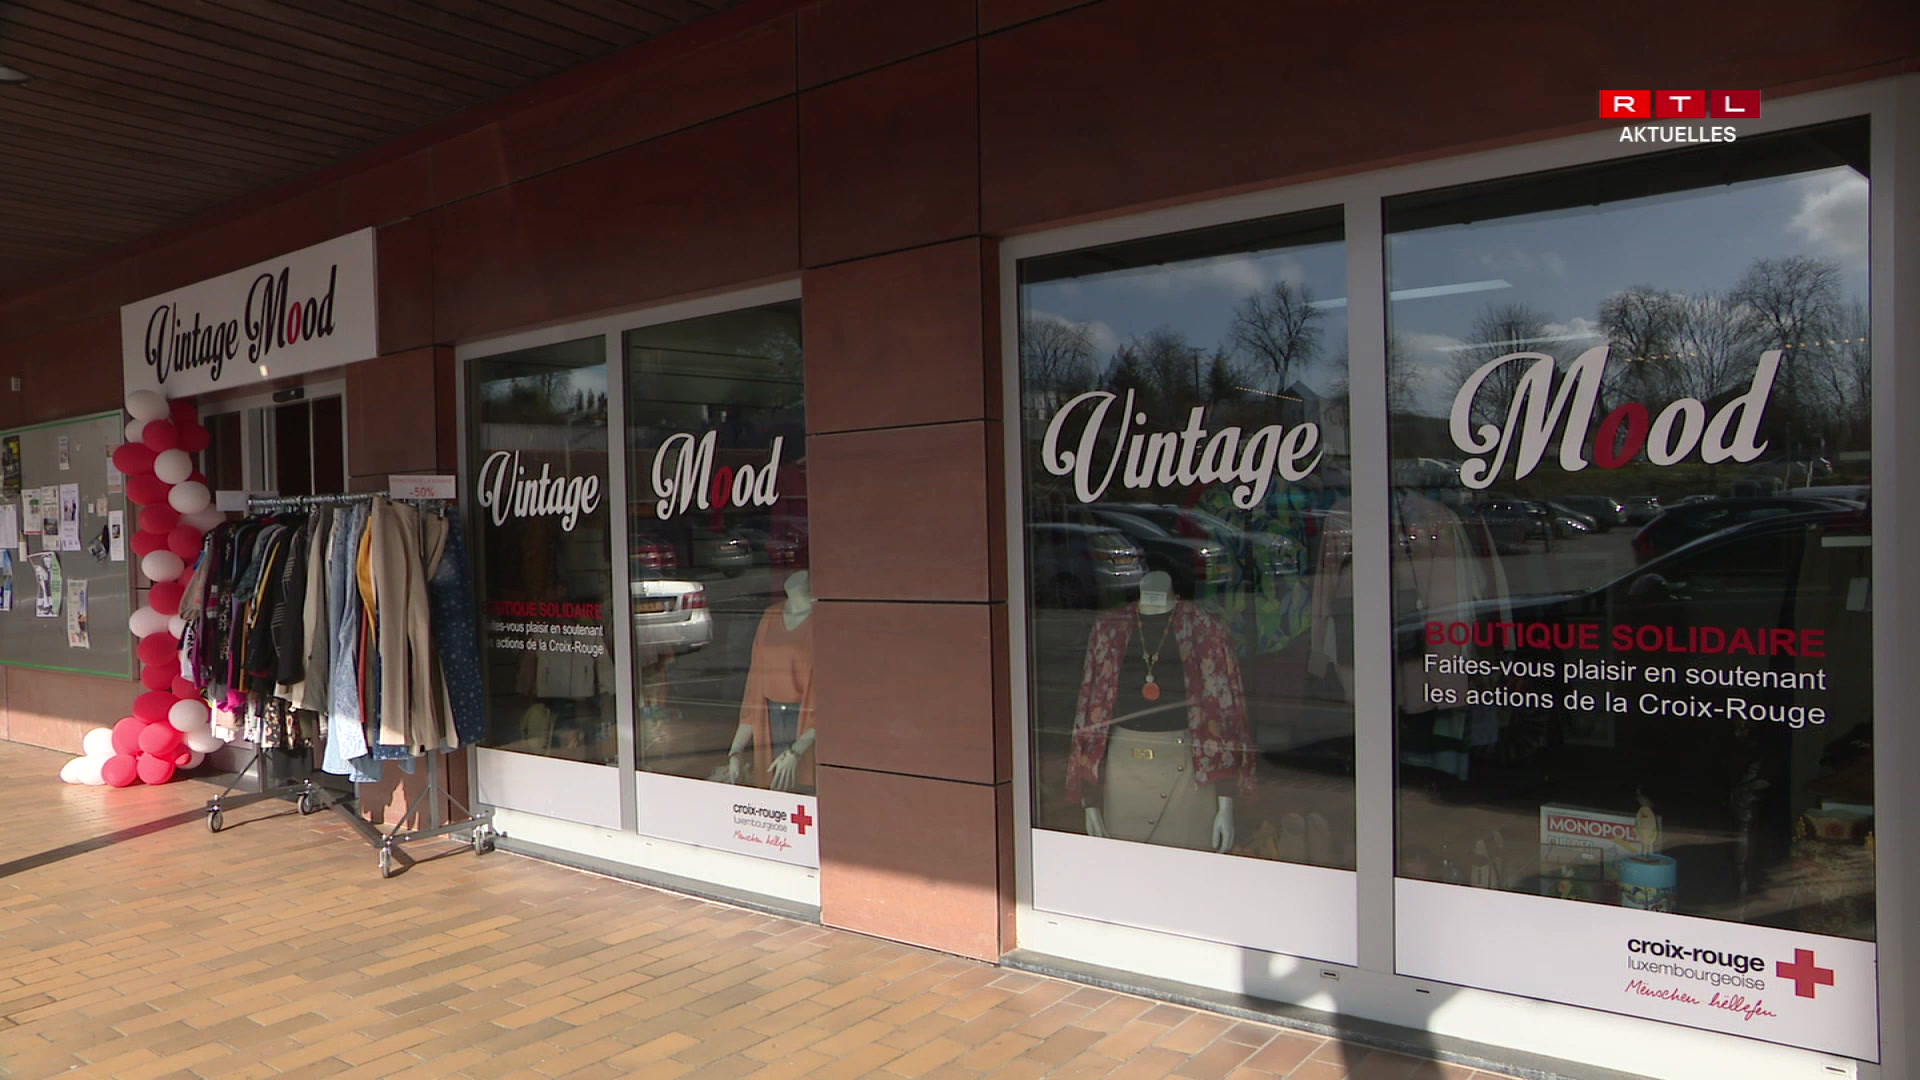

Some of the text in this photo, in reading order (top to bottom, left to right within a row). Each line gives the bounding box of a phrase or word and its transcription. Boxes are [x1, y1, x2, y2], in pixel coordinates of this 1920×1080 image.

[145, 264, 338, 384] Vintage Mood
[1041, 345, 1784, 510] Vintage Mood
[408, 486, 435, 497] -50%
[477, 430, 784, 532] Vintage Mood
[484, 600, 604, 619] UTIQUE SOLIDAIRE
[525, 621, 549, 636] plaisir
[550, 624, 561, 634] en
[562, 624, 604, 636] soutenant
[1424, 620, 1826, 658] BOUTIQUE SOLIDAIRE
[496, 637, 525, 650] actions
[526, 638, 537, 650] de
[539, 639, 547, 651] la
[548, 639, 604, 657] Croix-Rouge
[1424, 653, 1827, 691] Faites-vous plaisir en soutenant
[1423, 683, 1827, 728] les actions de la Croix-Rouge
[732, 803, 788, 822] croix-rouge
[1626, 956, 1766, 991] luxembourgeoise
[1627, 938, 1766, 974] croix-rouge
